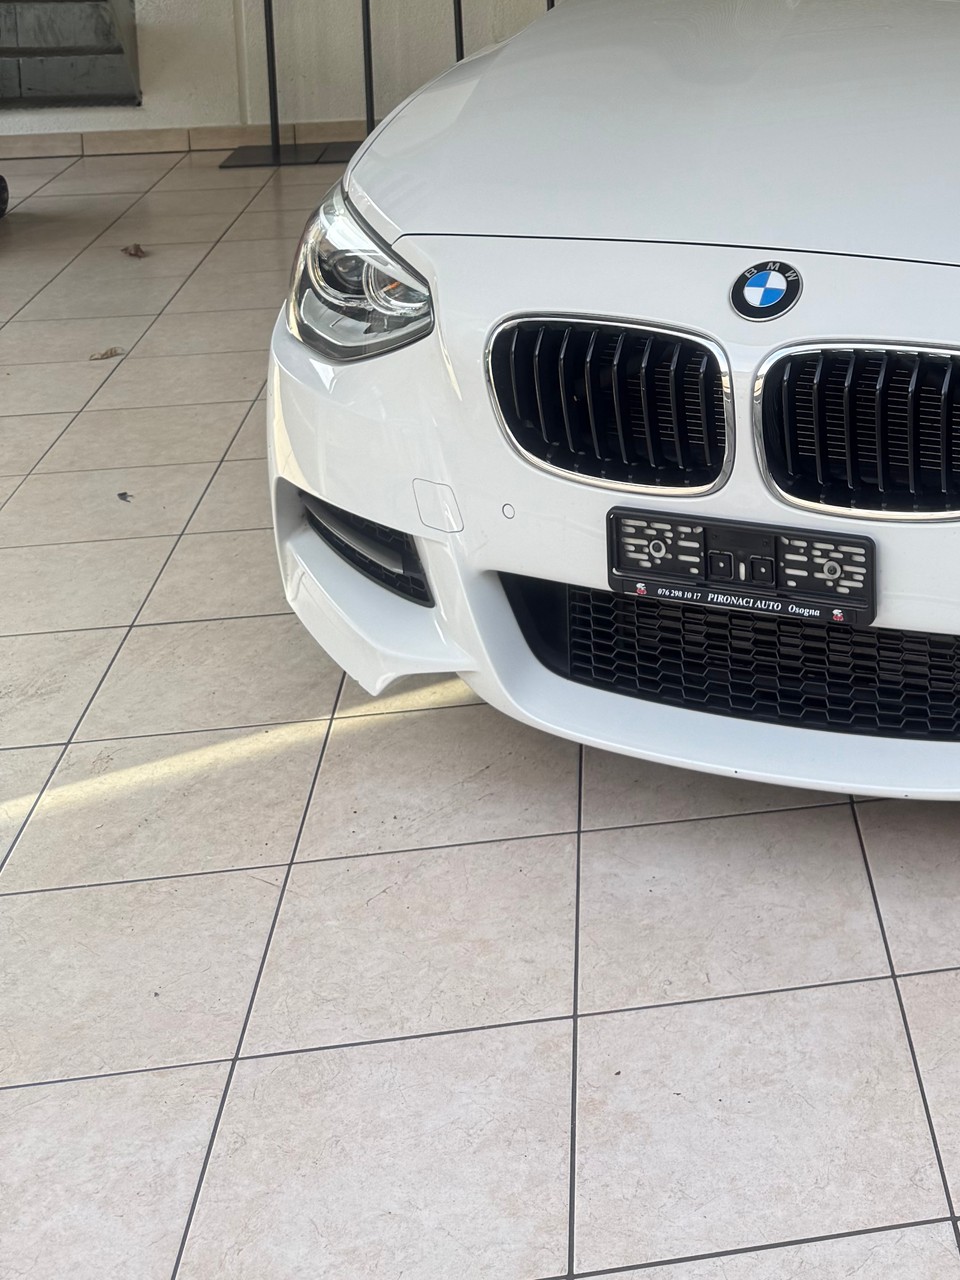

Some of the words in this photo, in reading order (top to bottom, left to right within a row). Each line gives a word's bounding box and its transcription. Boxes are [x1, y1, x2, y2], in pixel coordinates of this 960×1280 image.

[744, 262, 799, 281] BMW
[657, 588, 670, 596] 076
[670, 589, 683, 598] 298
[683, 591, 692, 599] 10
[693, 592, 702, 600] 17
[707, 593, 754, 607] PIRONACI
[754, 599, 782, 611] AUTO
[788, 604, 820, 617] Osogna
